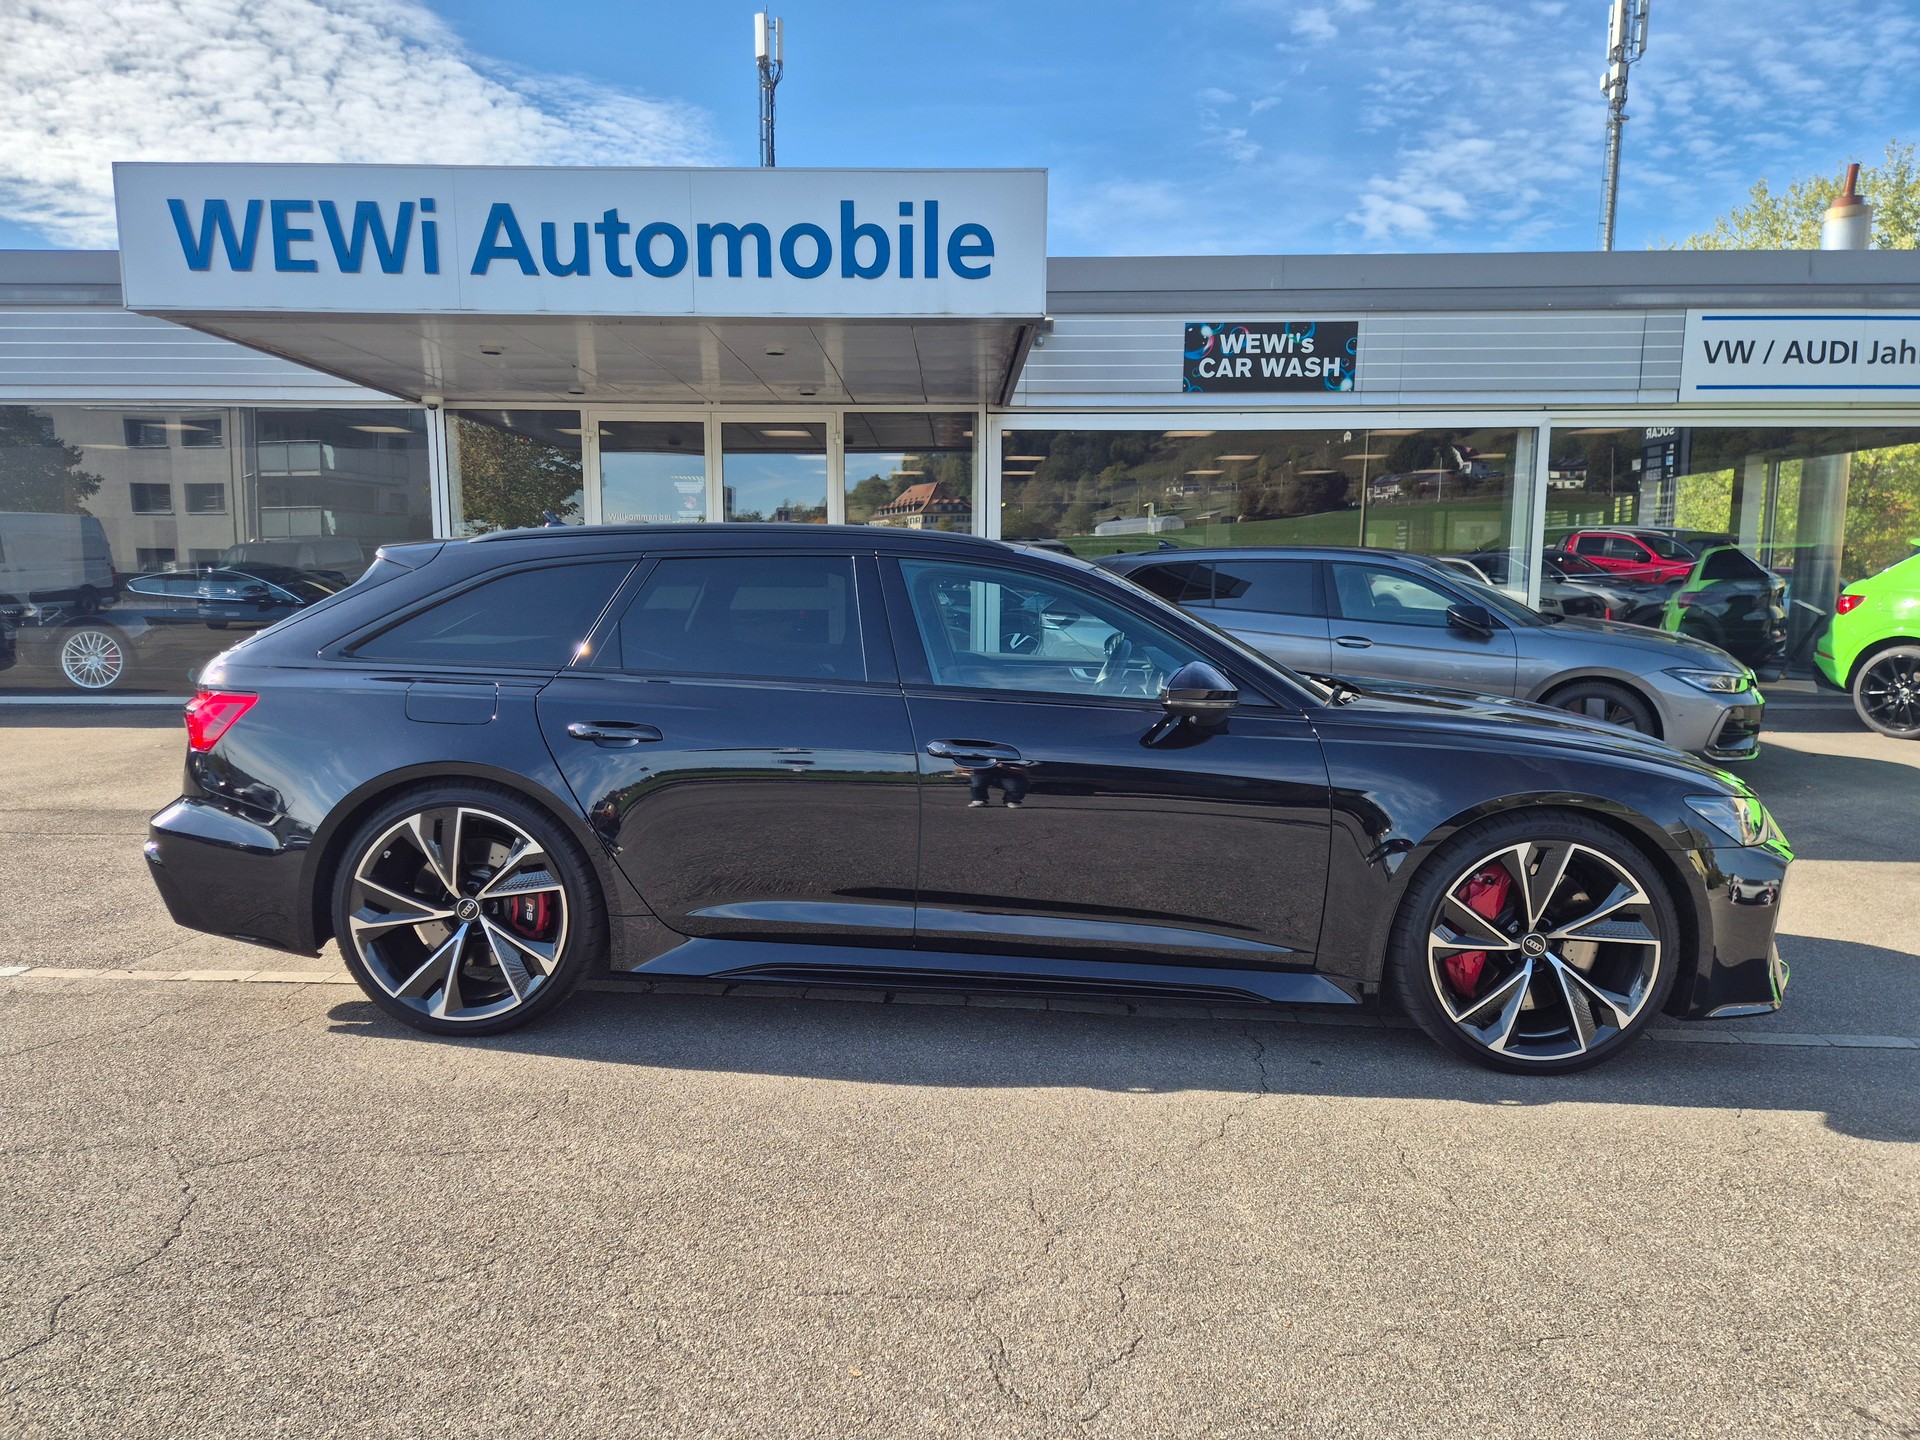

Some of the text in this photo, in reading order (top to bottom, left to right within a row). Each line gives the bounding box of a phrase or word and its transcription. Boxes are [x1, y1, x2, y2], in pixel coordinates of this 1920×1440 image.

[167, 197, 995, 281] WEWi Automobile
[1219, 332, 1315, 354] WEWi's
[1703, 338, 1920, 364] VW / AUDI Jah
[1199, 356, 1341, 379] CAR WASH
[608, 512, 658, 521] Willkommen
